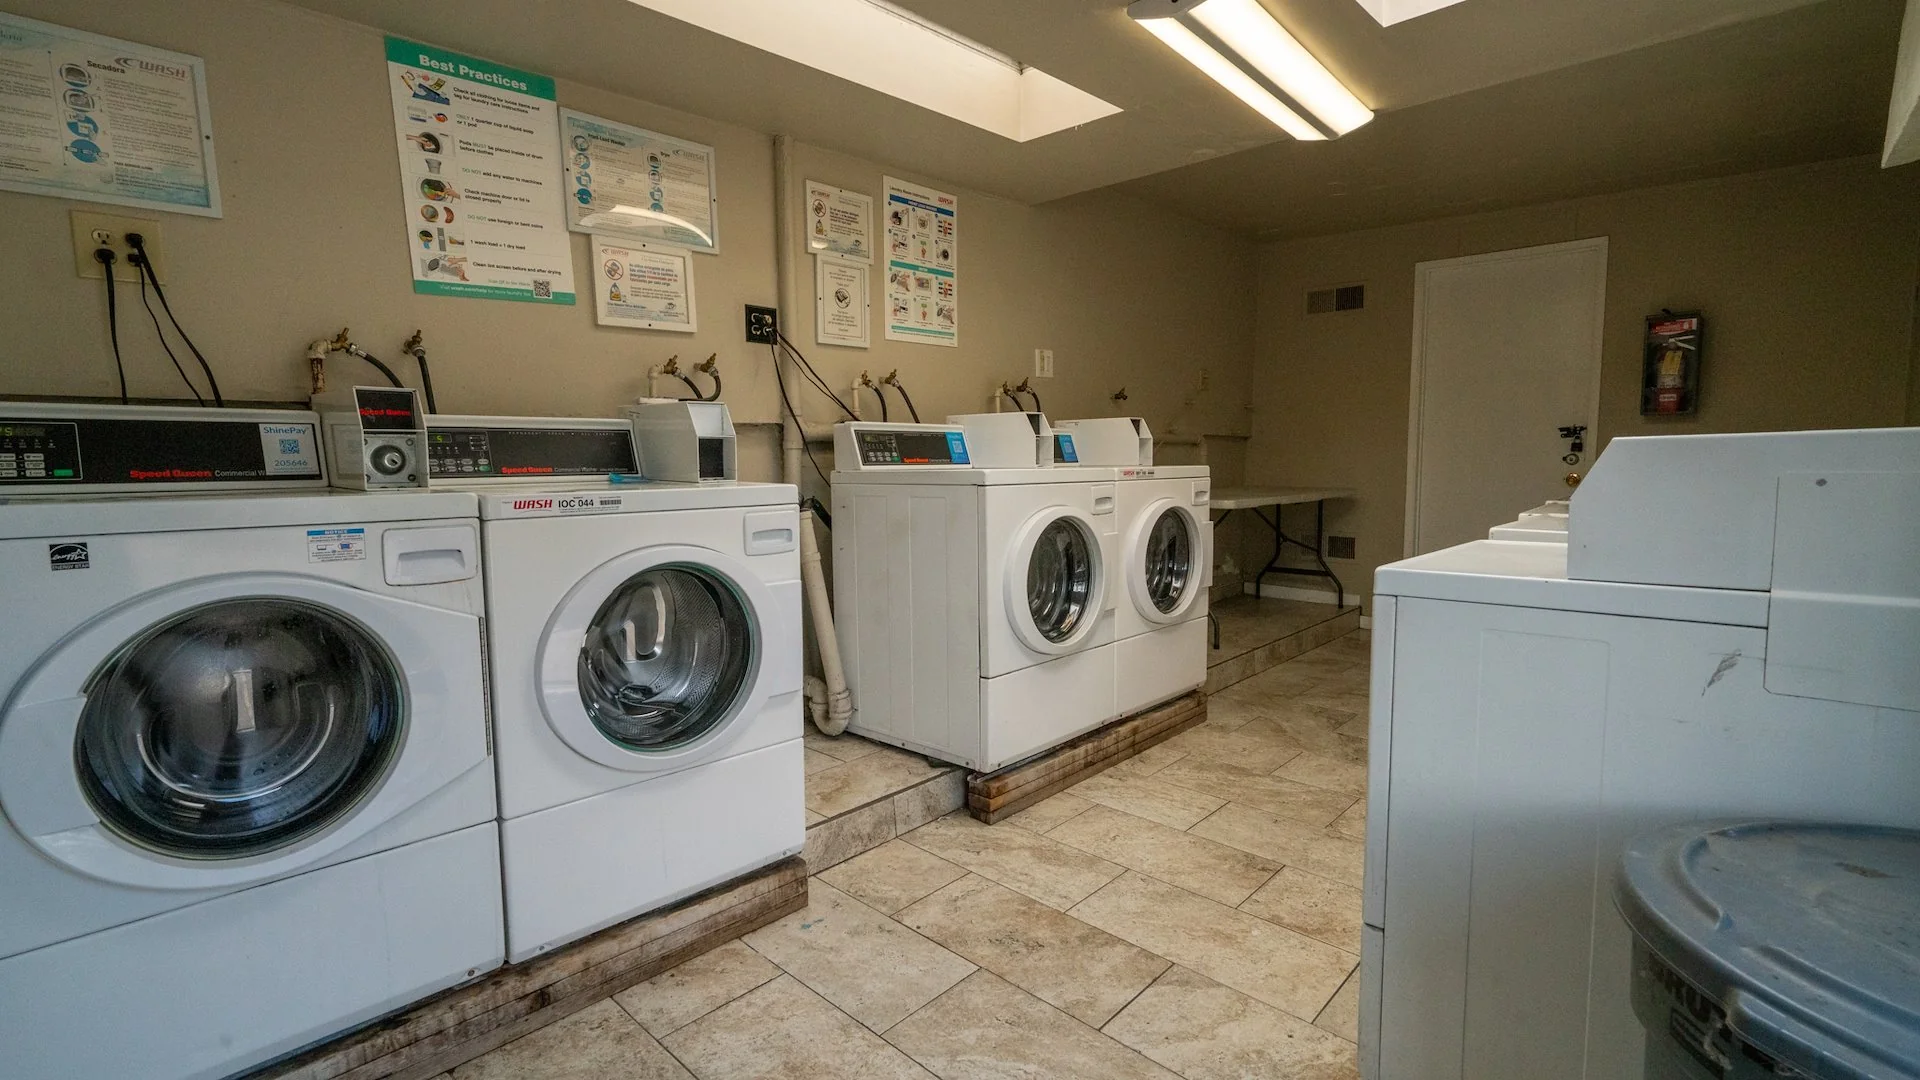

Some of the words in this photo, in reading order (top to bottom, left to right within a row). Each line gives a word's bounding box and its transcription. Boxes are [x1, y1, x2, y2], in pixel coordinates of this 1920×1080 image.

[86, 60, 126, 75] Secadora
[139, 60, 187, 78] WASH
[419, 54, 455, 73] Best
[458, 65, 528, 92] Practices
[452, 86, 470, 94] Check
[476, 91, 498, 102] clothing
[504, 97, 518, 105] loose
[517, 100, 532, 109] items
[470, 97, 488, 106] laundry
[500, 102, 529, 114] instructions
[475, 118, 493, 126] quarter
[509, 124, 522, 132] liquid
[476, 148, 495, 156] clothes
[495, 145, 511, 154] placed
[521, 177, 543, 186] machines
[464, 187, 481, 195] Check
[480, 190, 501, 199] machine
[481, 196, 502, 204] properly
[497, 218, 514, 226] foreign
[512, 264, 527, 272] before
[547, 268, 562, 276] drying
[358, 407, 385, 417] Speed
[385, 408, 412, 417] Queen
[263, 426, 306, 435] ShinePay
[274, 459, 308, 467] 205646
[129, 469, 170, 480] Speed
[172, 469, 213, 479] Queen
[214, 469, 261, 478] Commercial
[501, 466, 528, 475] Speed
[527, 465, 553, 474] Queen
[513, 499, 554, 510] WASH
[557, 499, 576, 509] IOC
[577, 499, 595, 508] 044
